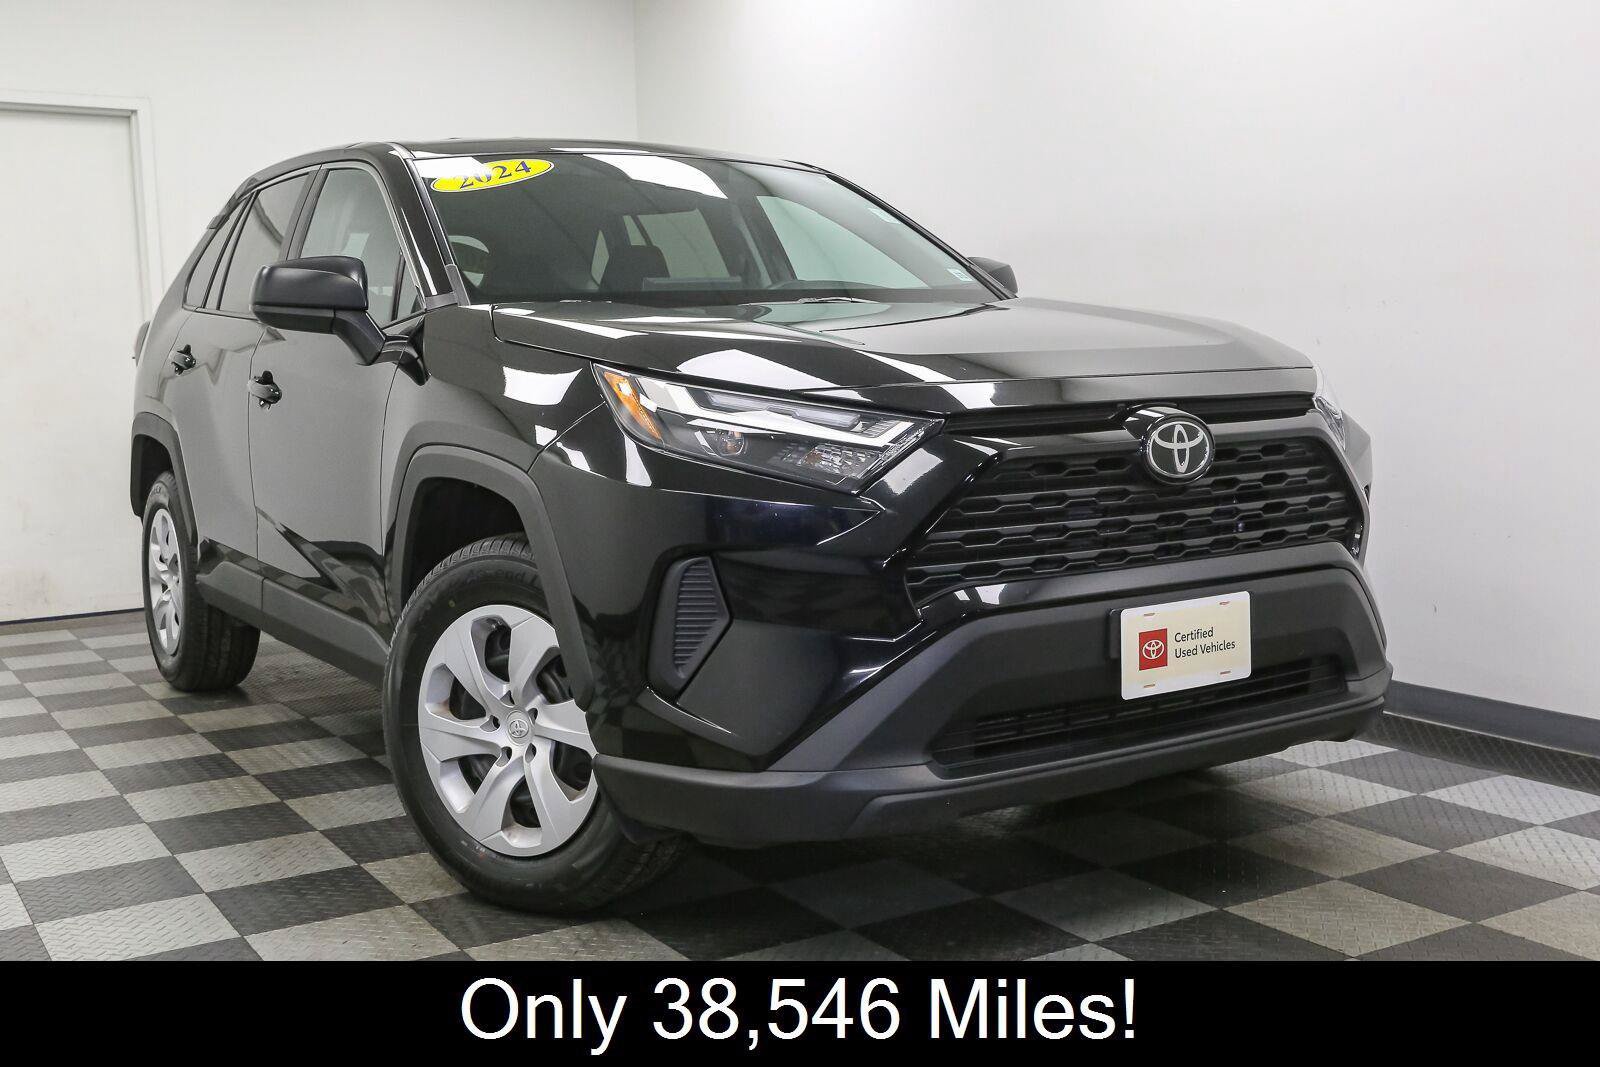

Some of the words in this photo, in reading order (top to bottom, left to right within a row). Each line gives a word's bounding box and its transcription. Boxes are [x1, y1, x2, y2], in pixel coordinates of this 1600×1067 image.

[1174, 627, 1214, 642] Certified
[1174, 645, 1198, 658] Used
[1200, 639, 1236, 654] Vehicles
